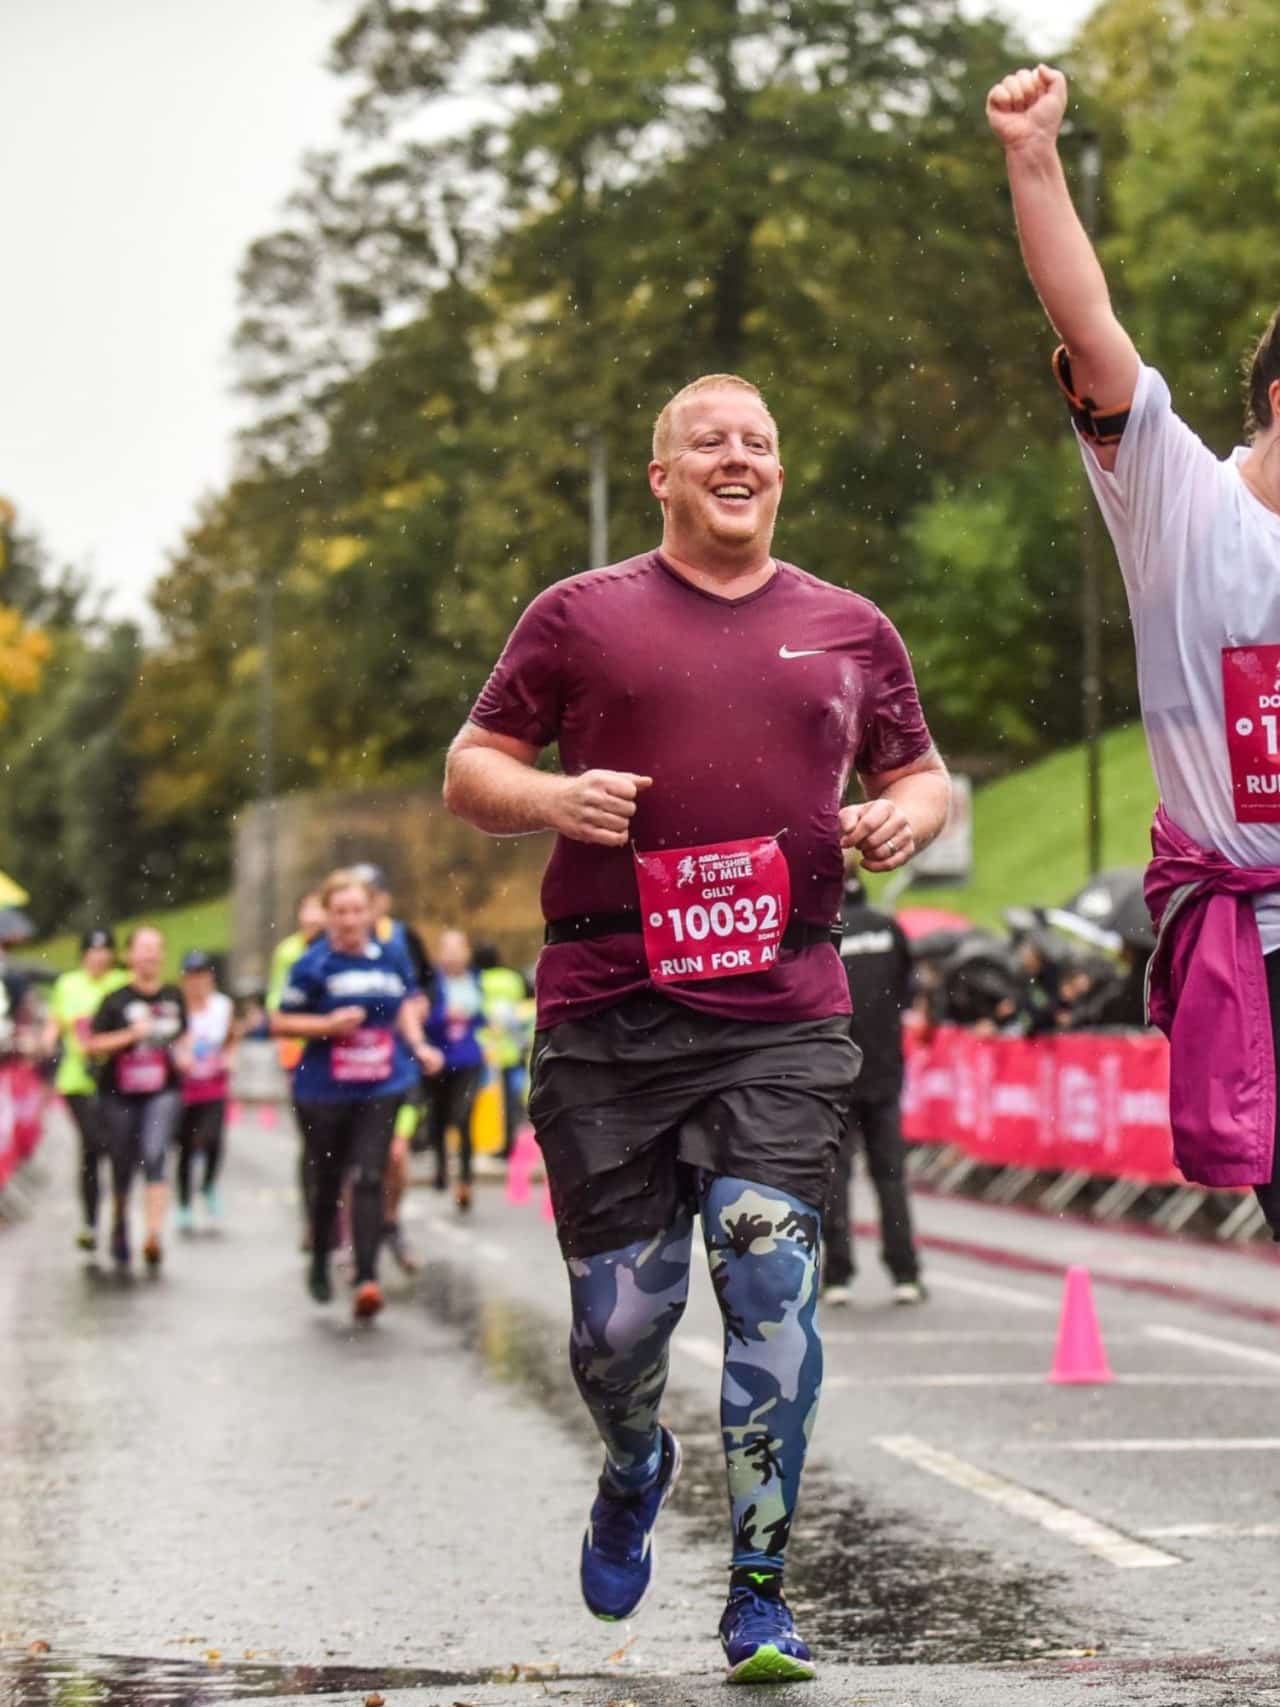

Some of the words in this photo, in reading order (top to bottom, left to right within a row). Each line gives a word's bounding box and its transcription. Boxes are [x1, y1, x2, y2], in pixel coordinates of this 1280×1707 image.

[701, 871, 716, 883] 10
[720, 865, 753, 880] MILE
[702, 885, 736, 899] GILLY
[668, 894, 779, 942] 10032
[661, 955, 703, 976] RUN
[711, 949, 752, 970] FOR
